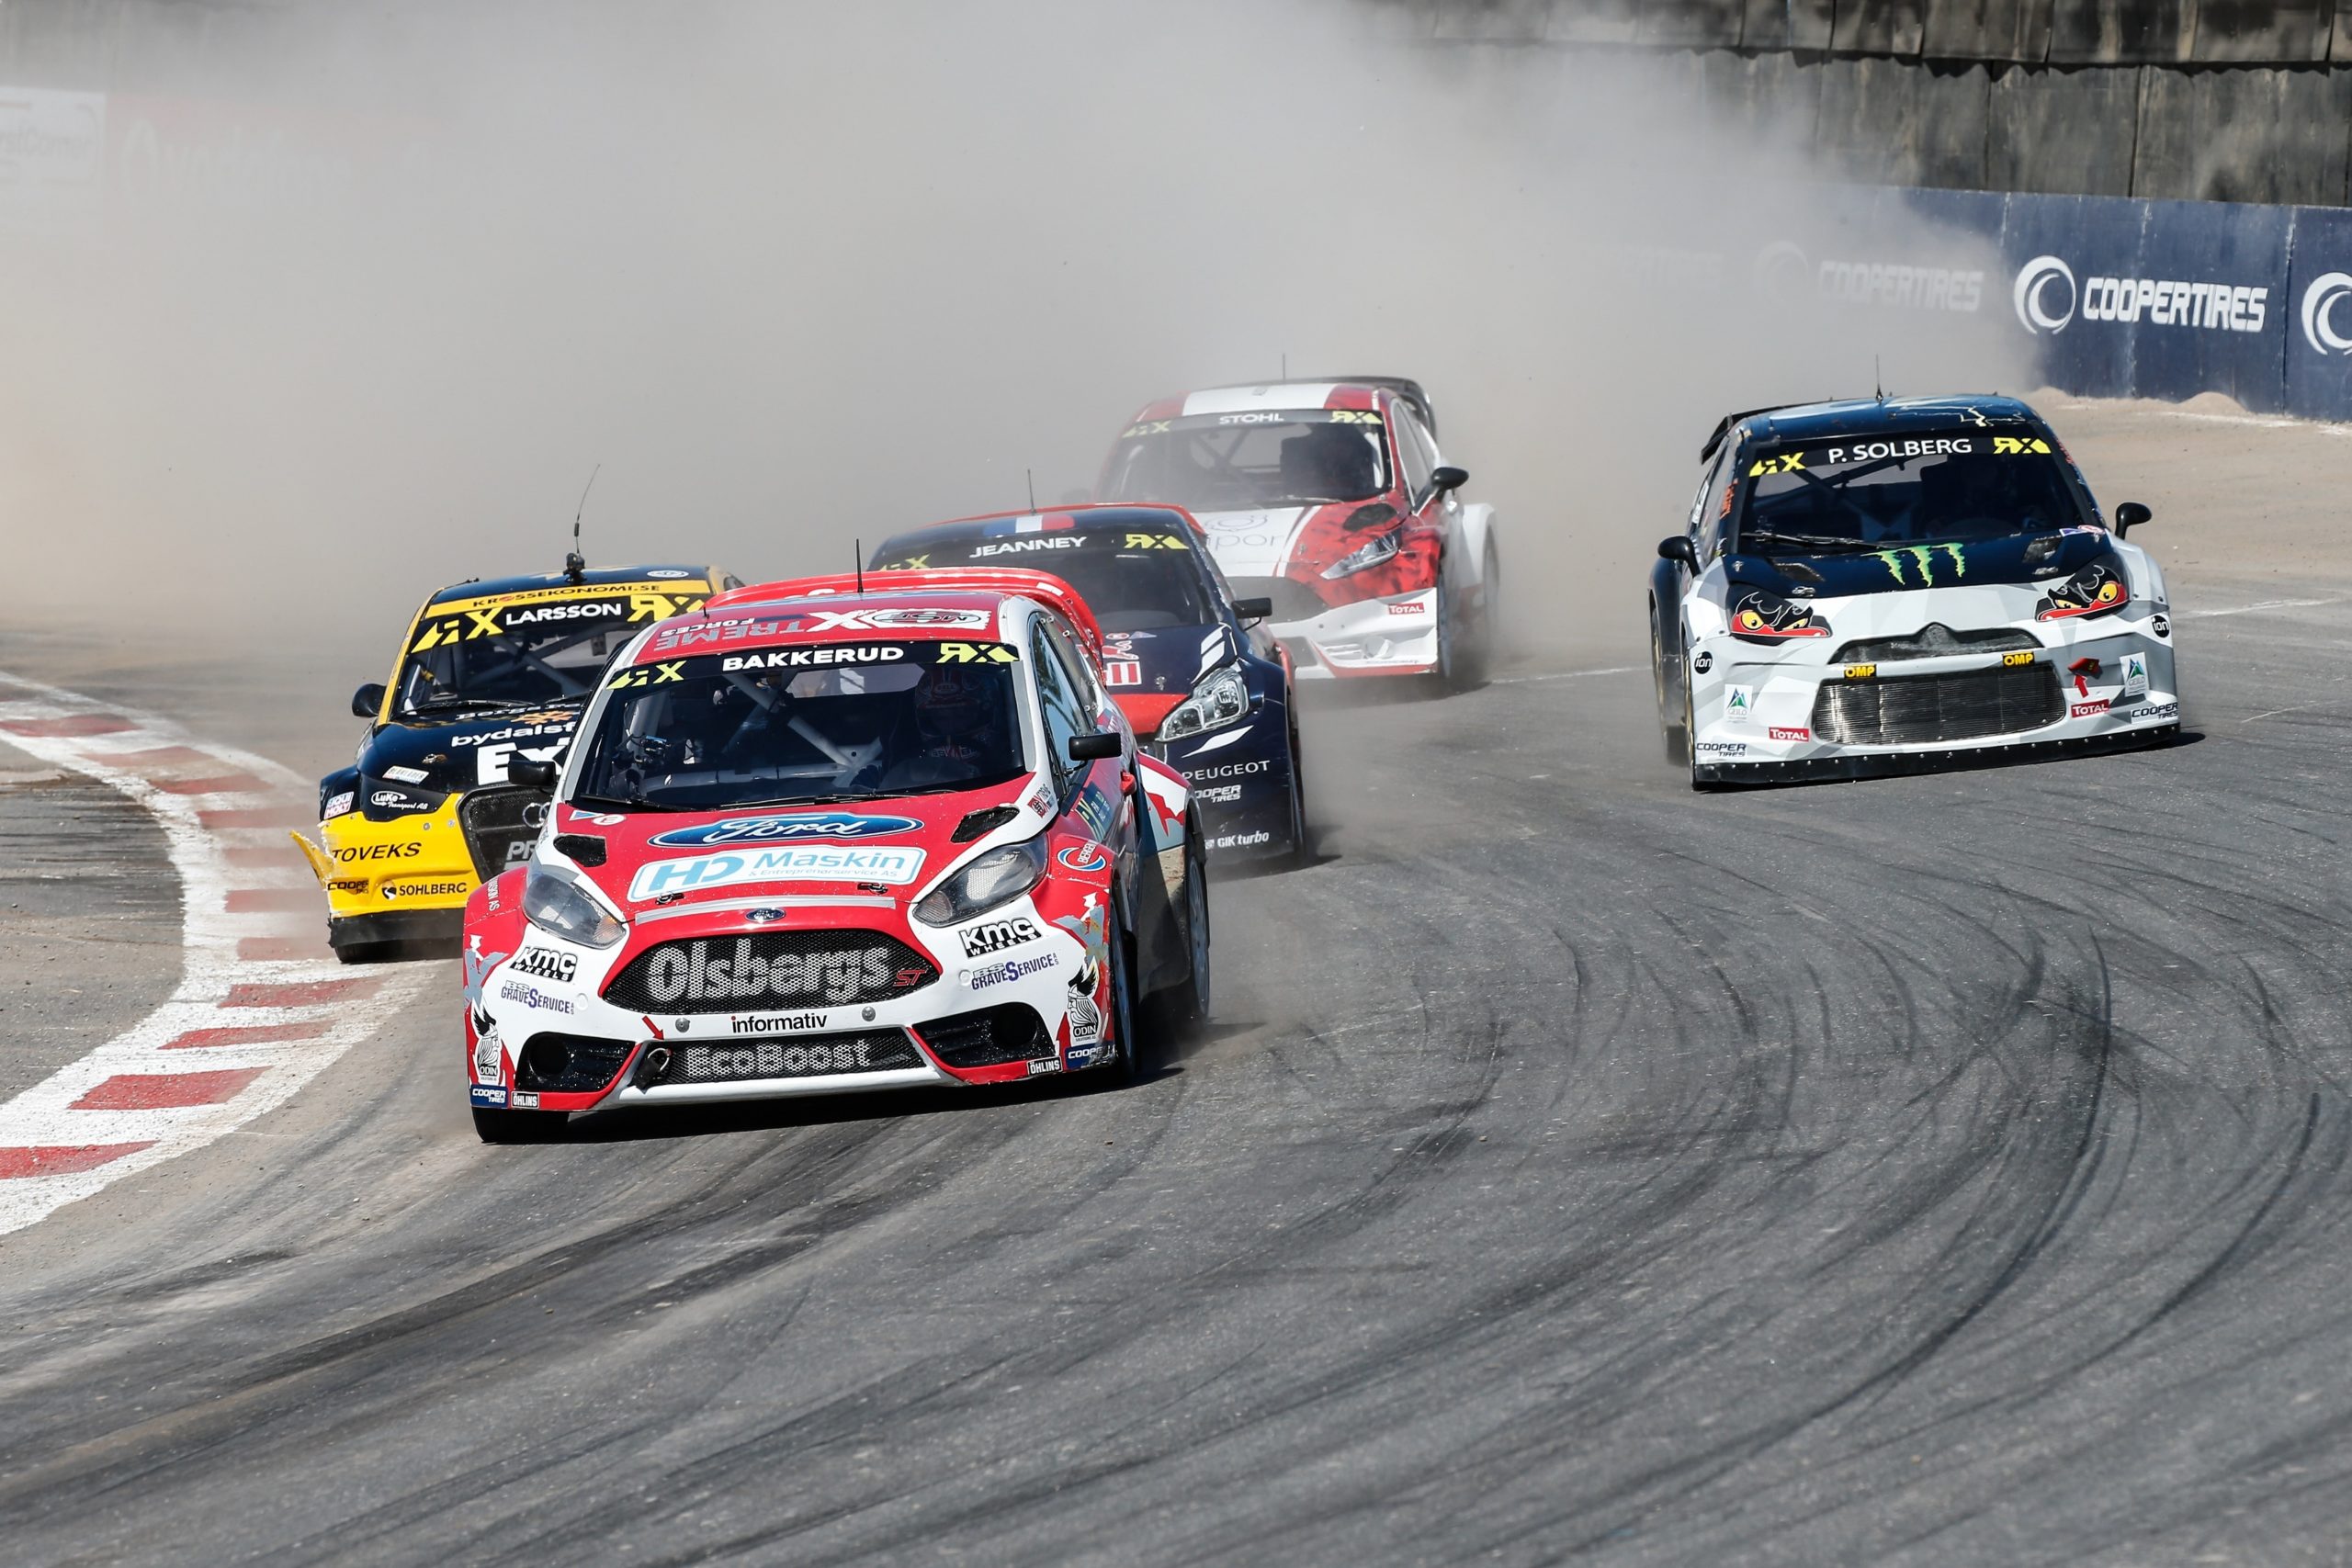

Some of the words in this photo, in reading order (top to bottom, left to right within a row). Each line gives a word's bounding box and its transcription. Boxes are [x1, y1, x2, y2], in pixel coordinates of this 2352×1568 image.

[1219, 413, 1284, 425] STOHL
[1828, 448, 1847, 465] P.
[1853, 438, 1973, 461] SOLBERG
[969, 536, 1087, 558] JEANNEY
[505, 603, 621, 626] LARSSON
[1389, 605, 1424, 614] TOTAL
[661, 617, 755, 637] FORCES
[722, 647, 905, 672] BAKKERUD
[2004, 653, 2035, 666] OMP
[1845, 666, 1876, 678] OMP
[2072, 704, 2109, 716] TOTAL
[2132, 702, 2178, 717] COOPER
[2158, 709, 2178, 719] TIRES
[1770, 729, 1808, 740] TOTAL
[1696, 743, 1747, 751] COOPER
[1182, 760, 1270, 781] PEUGEOT
[1211, 793, 1241, 803] TIRES
[702, 816, 868, 842] Ford
[1217, 834, 1237, 848] GIK
[1237, 830, 1270, 845] turbo
[332, 841, 423, 863] TOVEKS
[753, 852, 905, 870] Maskin
[399, 883, 468, 897] SOHLBERG
[969, 933, 1038, 956] WHEELS
[514, 963, 570, 982] WHEELS
[647, 938, 890, 1002] Olsbergs
[892, 967, 928, 987] ST
[730, 1013, 828, 1034] informativ
[1074, 1025, 1097, 1037] ODIN
[686, 1038, 871, 1077] EcoBoost
[480, 1066, 497, 1076] ODIN
[1030, 1059, 1060, 1075] ÖHLINS
[472, 1088, 506, 1099] COOPER
[513, 1091, 537, 1107] ÖHLINS
